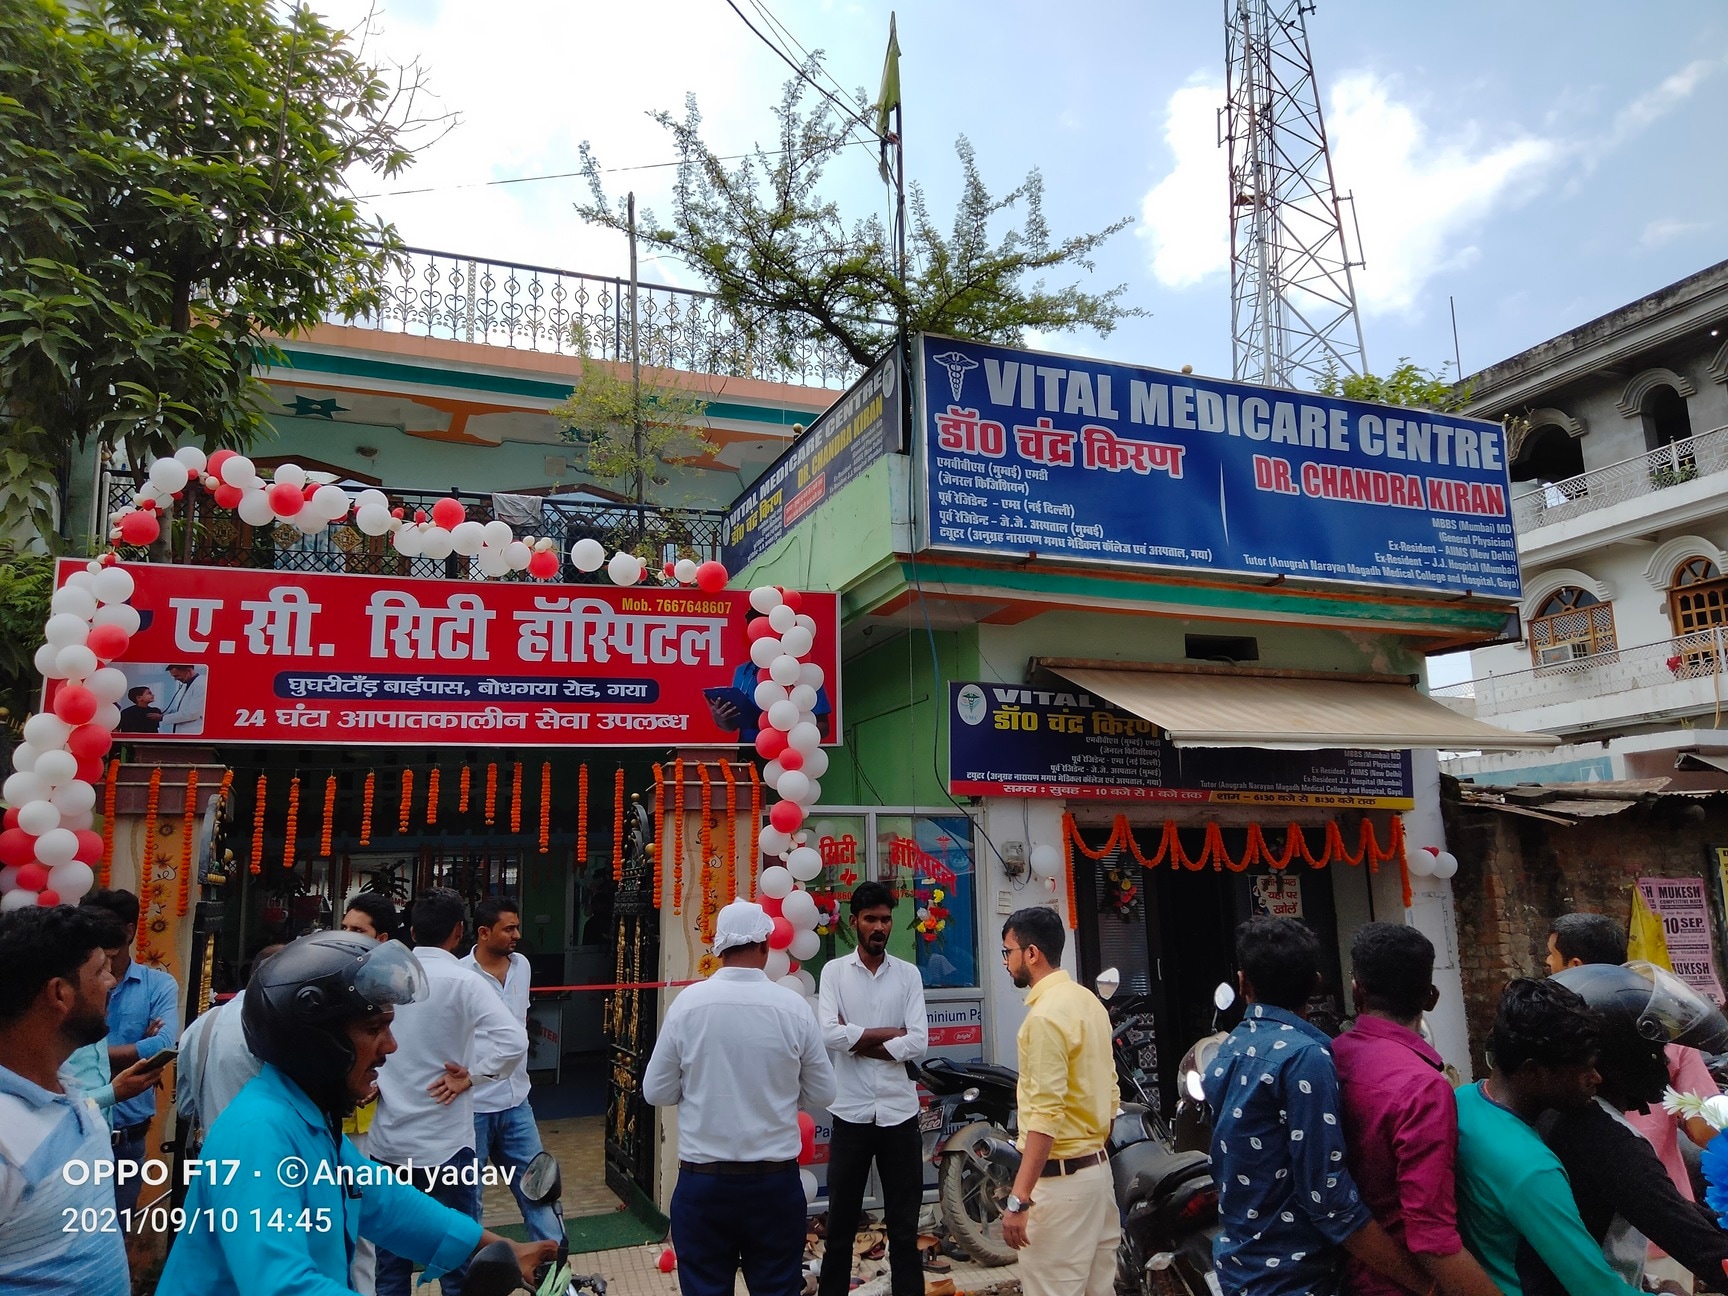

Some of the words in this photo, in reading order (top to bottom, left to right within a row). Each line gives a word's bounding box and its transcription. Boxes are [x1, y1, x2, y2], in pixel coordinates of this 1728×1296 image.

[983, 358, 1119, 421] VITAL
[1130, 379, 1350, 452] MEDICARE
[1358, 413, 1503, 471] CENTRE
[729, 492, 758, 527] VITAL
[760, 429, 823, 500] MEDICARE
[825, 370, 882, 438] CENTRE
[797, 463, 811, 489] DR.
[811, 423, 853, 475] CHANDRA
[853, 393, 883, 439] KIRAN
[1014, 417, 1078, 468] चंद्र
[1081, 424, 1186, 479] किरण
[1025, 468, 1048, 481] एमडी
[1252, 453, 1300, 496] DR.
[1299, 460, 1427, 510] CHANDRA
[1425, 476, 1507, 518] KIRAN
[759, 488, 783, 523] किरण
[938, 490, 952, 505] पूर्व
[1024, 499, 1042, 514] (नई
[1043, 502, 1075, 518] दिल्ली)
[939, 509, 953, 524] पूर्व
[1030, 519, 1068, 533] अस्पताल
[1432, 517, 1457, 530] MBBS
[1458, 520, 1495, 534] (Mumbai)
[1497, 523, 1512, 534] MD
[1006, 533, 1042, 546] नारायण
[1044, 536, 1066, 548] मगध
[1067, 536, 1101, 550] मेडिकल
[1102, 540, 1131, 553] कॉलेज
[1133, 543, 1147, 555] एवं
[1149, 546, 1189, 560] अस्पताल,
[1190, 548, 1213, 562] गया)
[1388, 540, 1436, 554] Ex-Resident
[1470, 548, 1490, 559] (New
[1491, 550, 1516, 562] Delhi)
[1439, 532, 1471, 545] (General
[1473, 536, 1514, 549] Physician)
[1243, 553, 1267, 567] Tutor
[1268, 556, 1309, 570] (Anugrah
[1310, 560, 1346, 573] Narayan
[1347, 563, 1381, 576] Magadh
[1382, 566, 1414, 579] Medical
[1415, 569, 1446, 583] College
[1447, 573, 1461, 584] and
[1462, 575, 1496, 587] Hospital,
[1497, 577, 1519, 590] Gaya)
[1374, 552, 1422, 566] Ex-Resident
[1449, 559, 1479, 573] Hospital
[1480, 562, 1518, 576] (Mumbai)
[621, 597, 652, 613] Mob.
[656, 599, 732, 615] 7667648607
[169, 586, 335, 657] ए.सी.
[365, 590, 497, 661] सिटी
[513, 596, 728, 667] हॉस्पिटल
[384, 676, 471, 697] बाईपास,
[478, 678, 558, 696] बोधगया
[563, 679, 600, 698] रोड,
[608, 684, 647, 698] गया
[992, 688, 1096, 708] VITAL
[234, 709, 266, 727] 24
[275, 703, 329, 729] घंटा
[337, 706, 528, 730] आपातकालीन
[535, 707, 591, 730] सेवा
[597, 713, 690, 731] उपलब्ध
[1047, 708, 1085, 734] चंद्र
[1091, 712, 1159, 738] किरण
[1348, 759, 1371, 767] (General
[1372, 761, 1402, 770] Physician)
[1363, 751, 1390, 760] (Mumbai)
[1391, 752, 1401, 760] MD
[1014, 773, 1039, 782] नारायण
[1041, 774, 1057, 782] मगध
[1058, 773, 1082, 783] मेडिकल
[1083, 775, 1104, 784] कॉलेज
[1105, 776, 1115, 785] एवं
[1351, 777, 1375, 786] Hospital
[1376, 778, 1402, 787] (Mumbai)
[1370, 769, 1384, 777] (New
[1385, 769, 1402, 778] Delhi)
[1003, 785, 1037, 794] समय
[1050, 785, 1079, 796] सुबह
[1095, 788, 1107, 796] 10
[1111, 787, 1130, 797] बजे
[1134, 788, 1146, 797] से
[1158, 789, 1179, 799] बजे
[1181, 791, 1203, 800] तक
[1200, 780, 1217, 788] Tutor
[1218, 780, 1247, 790] (Anugrah
[1249, 782, 1274, 791] Narayan
[1275, 783, 1300, 792] Magadh
[1301, 784, 1324, 792] Medical
[1326, 785, 1348, 795] College
[1349, 786, 1359, 794] and
[1386, 788, 1403, 797] Gaya)
[1216, 792, 1240, 801] शाम
[1254, 794, 1275, 802] 6:30
[1277, 793, 1297, 803] बजे
[1298, 794, 1309, 803] से
[1314, 796, 1335, 804] 8:30
[1336, 796, 1355, 805] बजे
[1357, 797, 1376, 805] तक
[818, 833, 858, 867] सिटी
[1658, 886, 1701, 899] MUKESH
[1273, 902, 1298, 914] खोलें
[1663, 917, 1679, 934] 10
[1680, 918, 1704, 928] SEP.
[927, 1009, 966, 1023] minium
